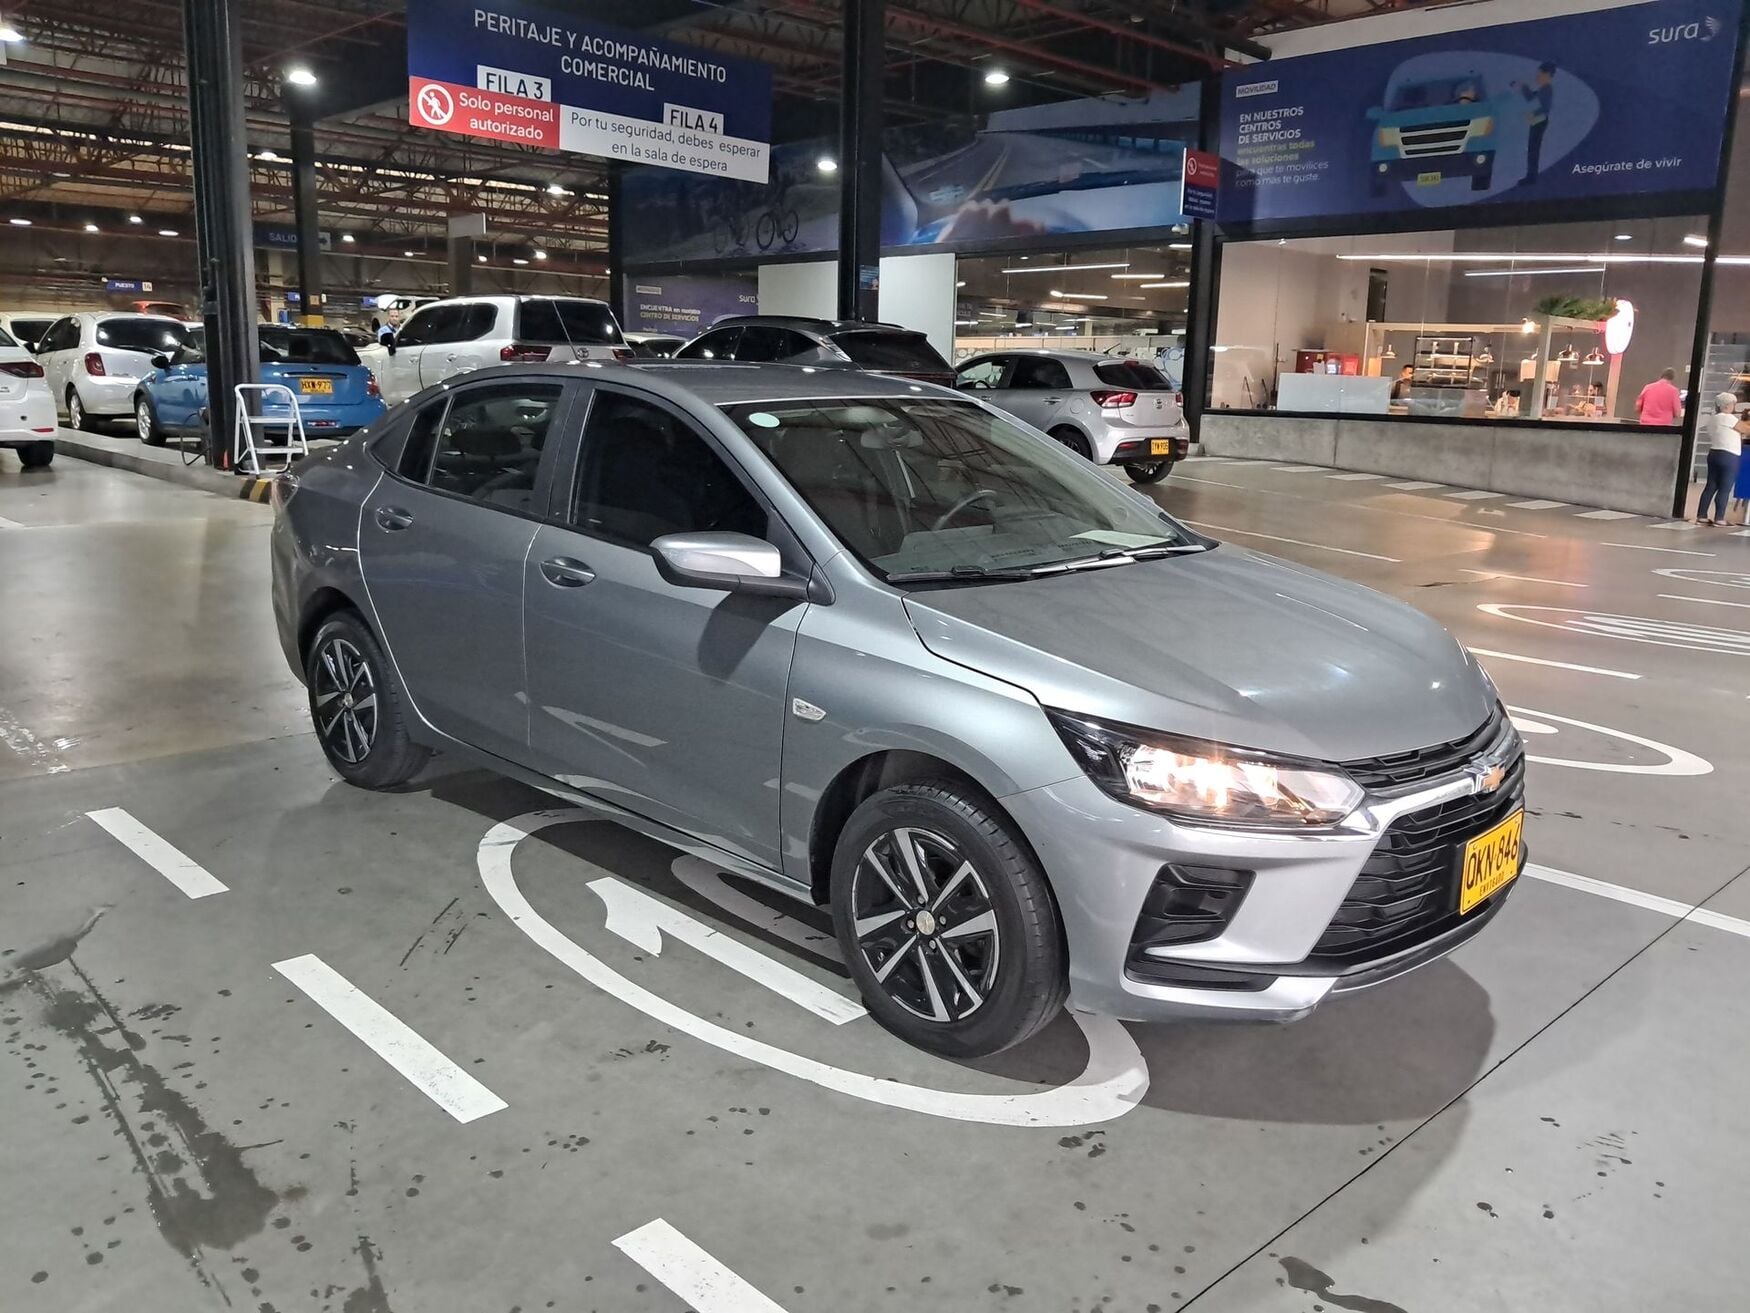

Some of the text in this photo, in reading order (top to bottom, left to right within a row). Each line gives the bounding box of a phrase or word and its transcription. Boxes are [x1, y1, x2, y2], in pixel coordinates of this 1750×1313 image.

[474, 9, 726, 83] PERITAJE Y ACOMPAÑAMIENTO
[1648, 22, 1700, 45] sura
[486, 72, 544, 99] FILA 3
[561, 55, 655, 91] COMERCIAL
[459, 92, 554, 122] Solo personal
[1239, 106, 1304, 123] EN NUESTROS
[469, 118, 544, 140] autorizado
[670, 109, 718, 134] FILA 4
[1239, 120, 1282, 133] CENTROS
[571, 112, 761, 158] Por tu seguridad, debes esperar
[1238, 129, 1302, 144] DE SERVICIOS
[611, 143, 728, 172] en la sala de espera
[1571, 157, 1682, 175] Asegúrate de vivir
